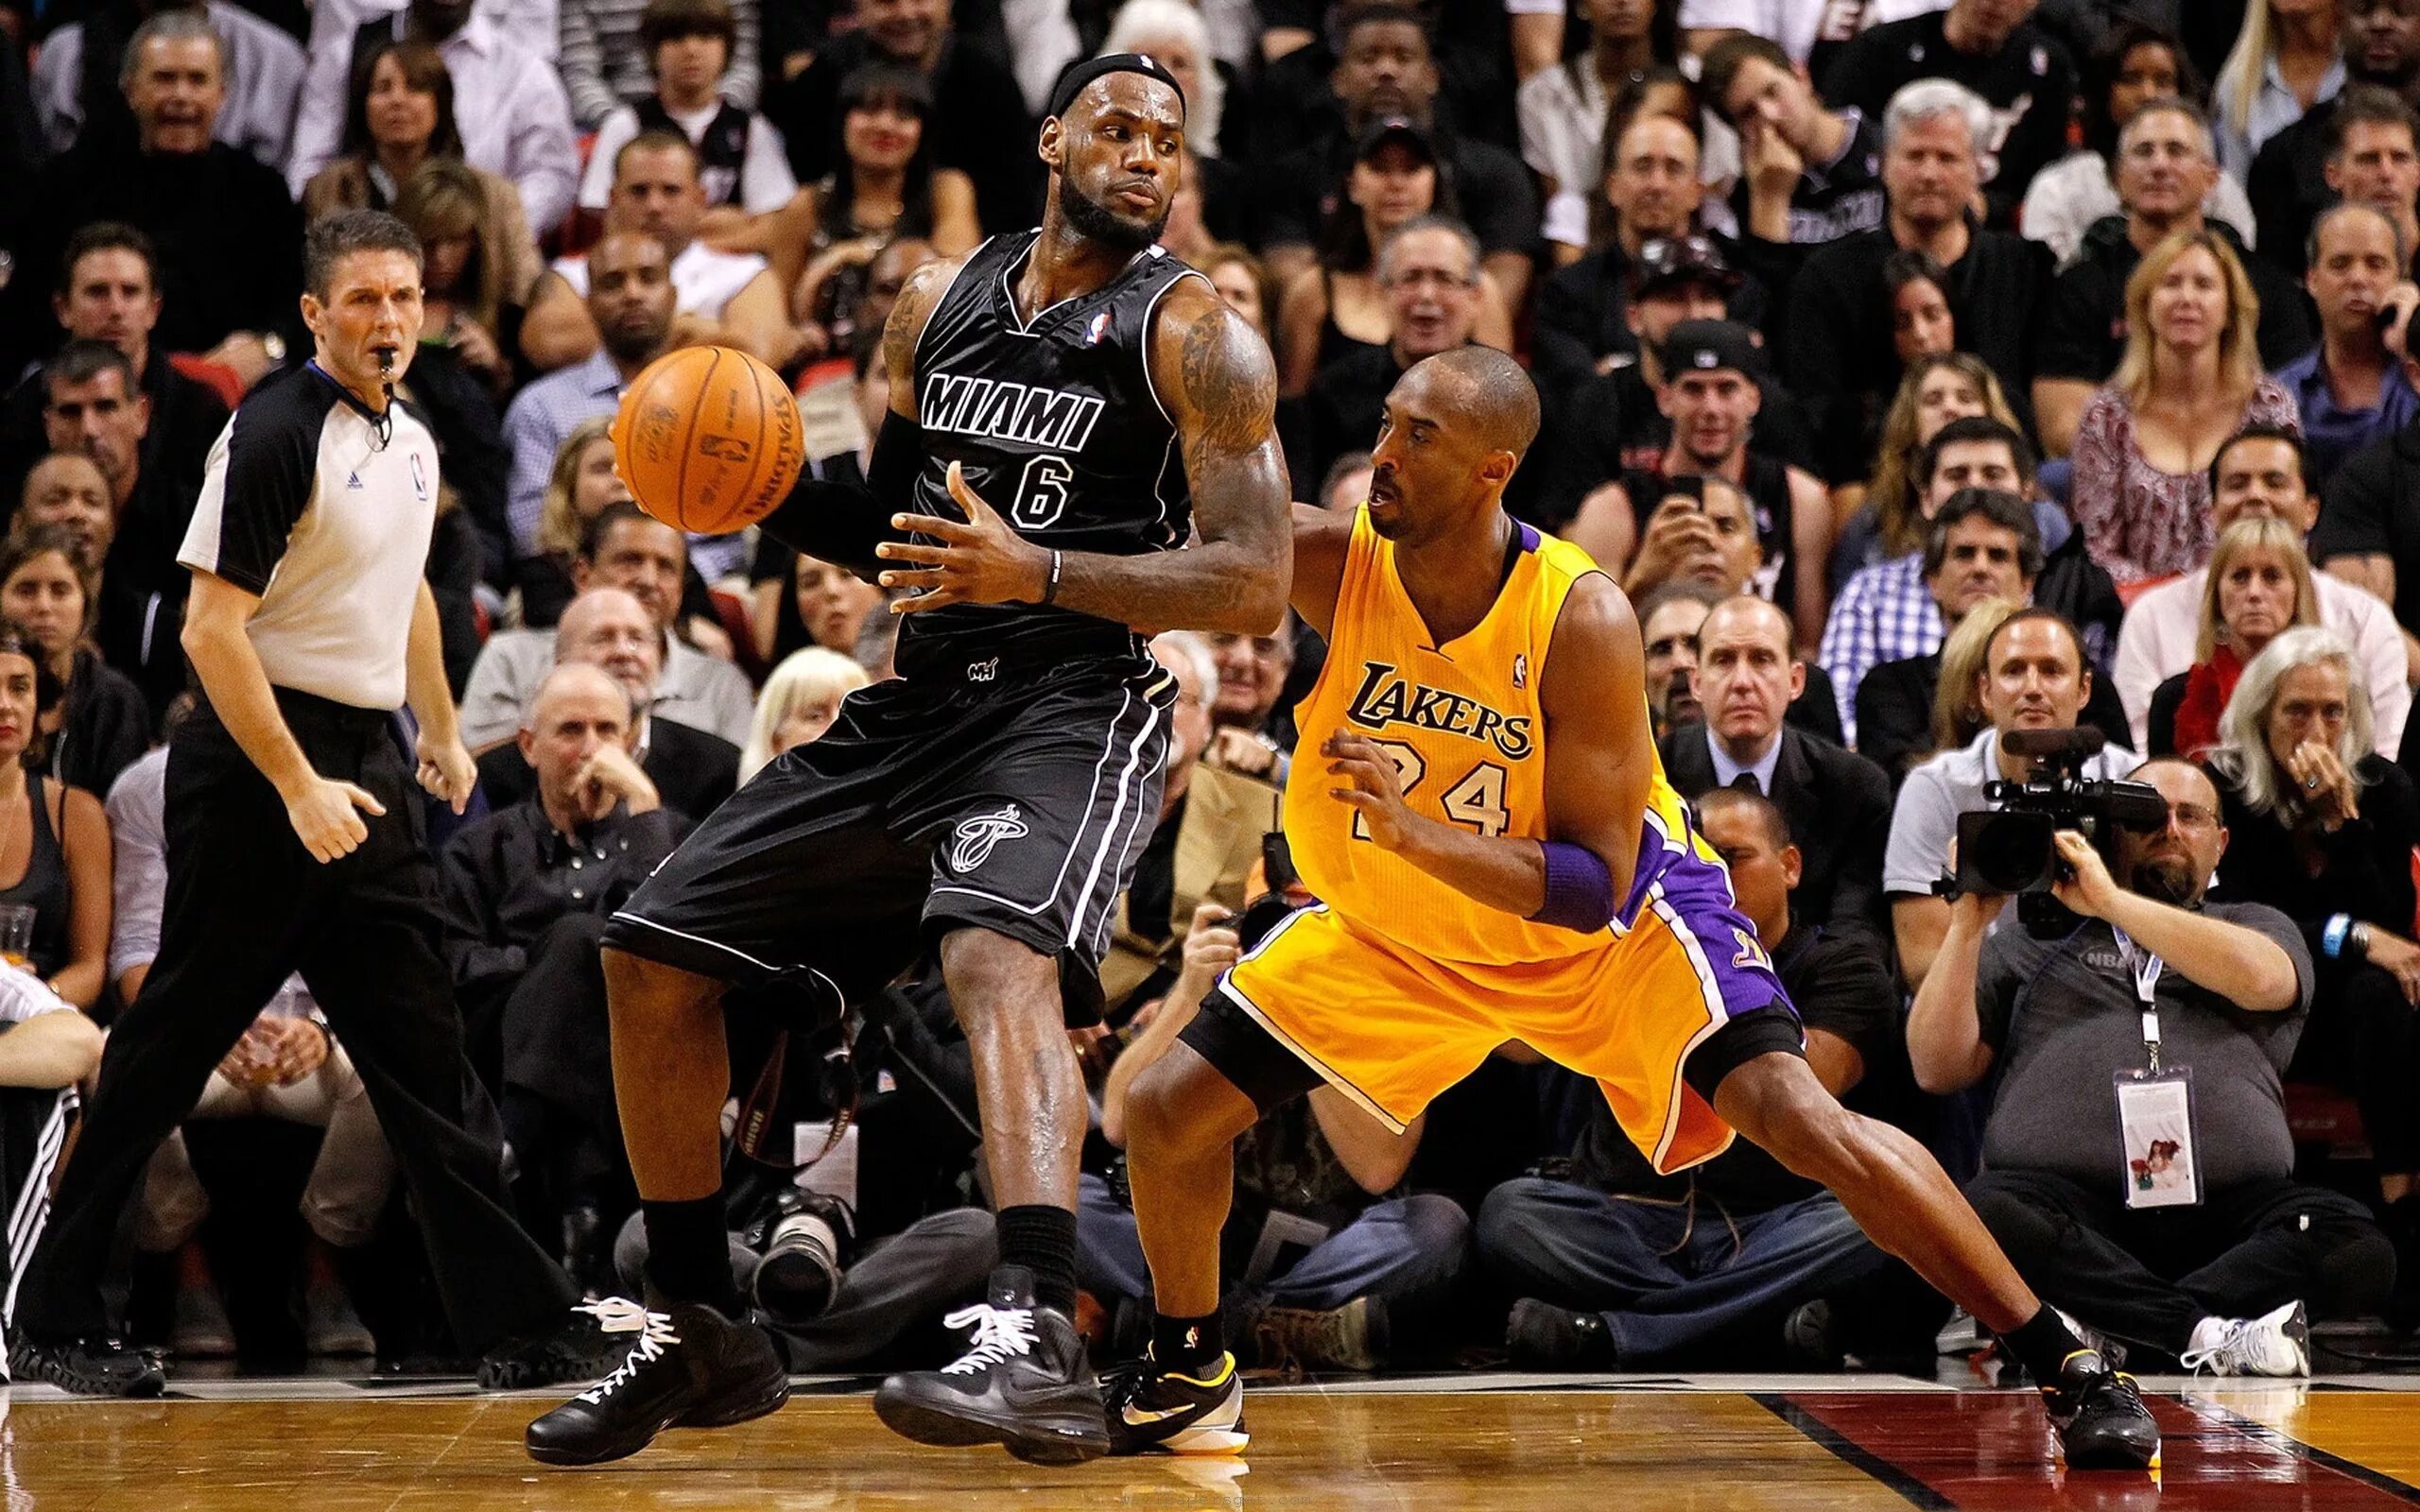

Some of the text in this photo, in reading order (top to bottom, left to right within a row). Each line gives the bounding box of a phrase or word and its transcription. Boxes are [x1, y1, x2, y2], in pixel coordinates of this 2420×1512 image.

[921, 372, 1106, 453] MIAMI
[1011, 454, 1074, 529] 6
[1346, 660, 1535, 762] LAKERS
